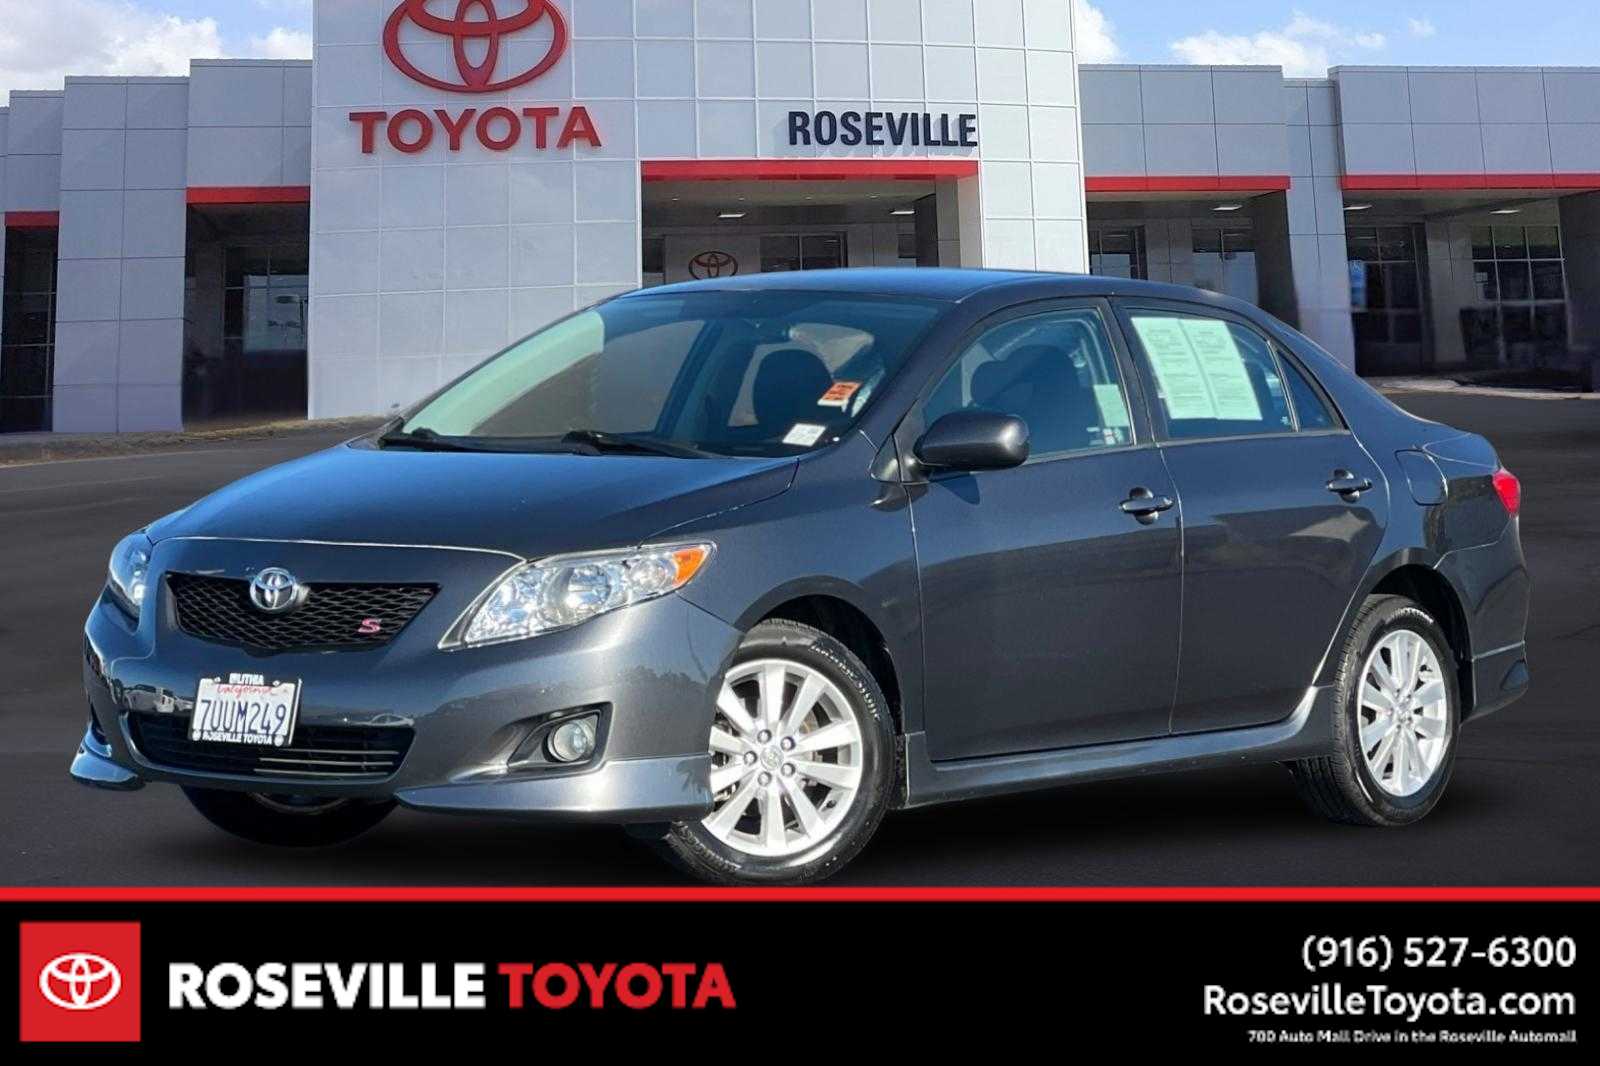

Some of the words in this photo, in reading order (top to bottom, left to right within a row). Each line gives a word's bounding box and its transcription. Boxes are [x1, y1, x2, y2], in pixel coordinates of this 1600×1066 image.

[349, 105, 603, 154] TOYOTA
[788, 110, 979, 148] ROSEVILLE
[202, 731, 242, 743] ROSEVILLE
[243, 733, 273, 745] TOYOTA
